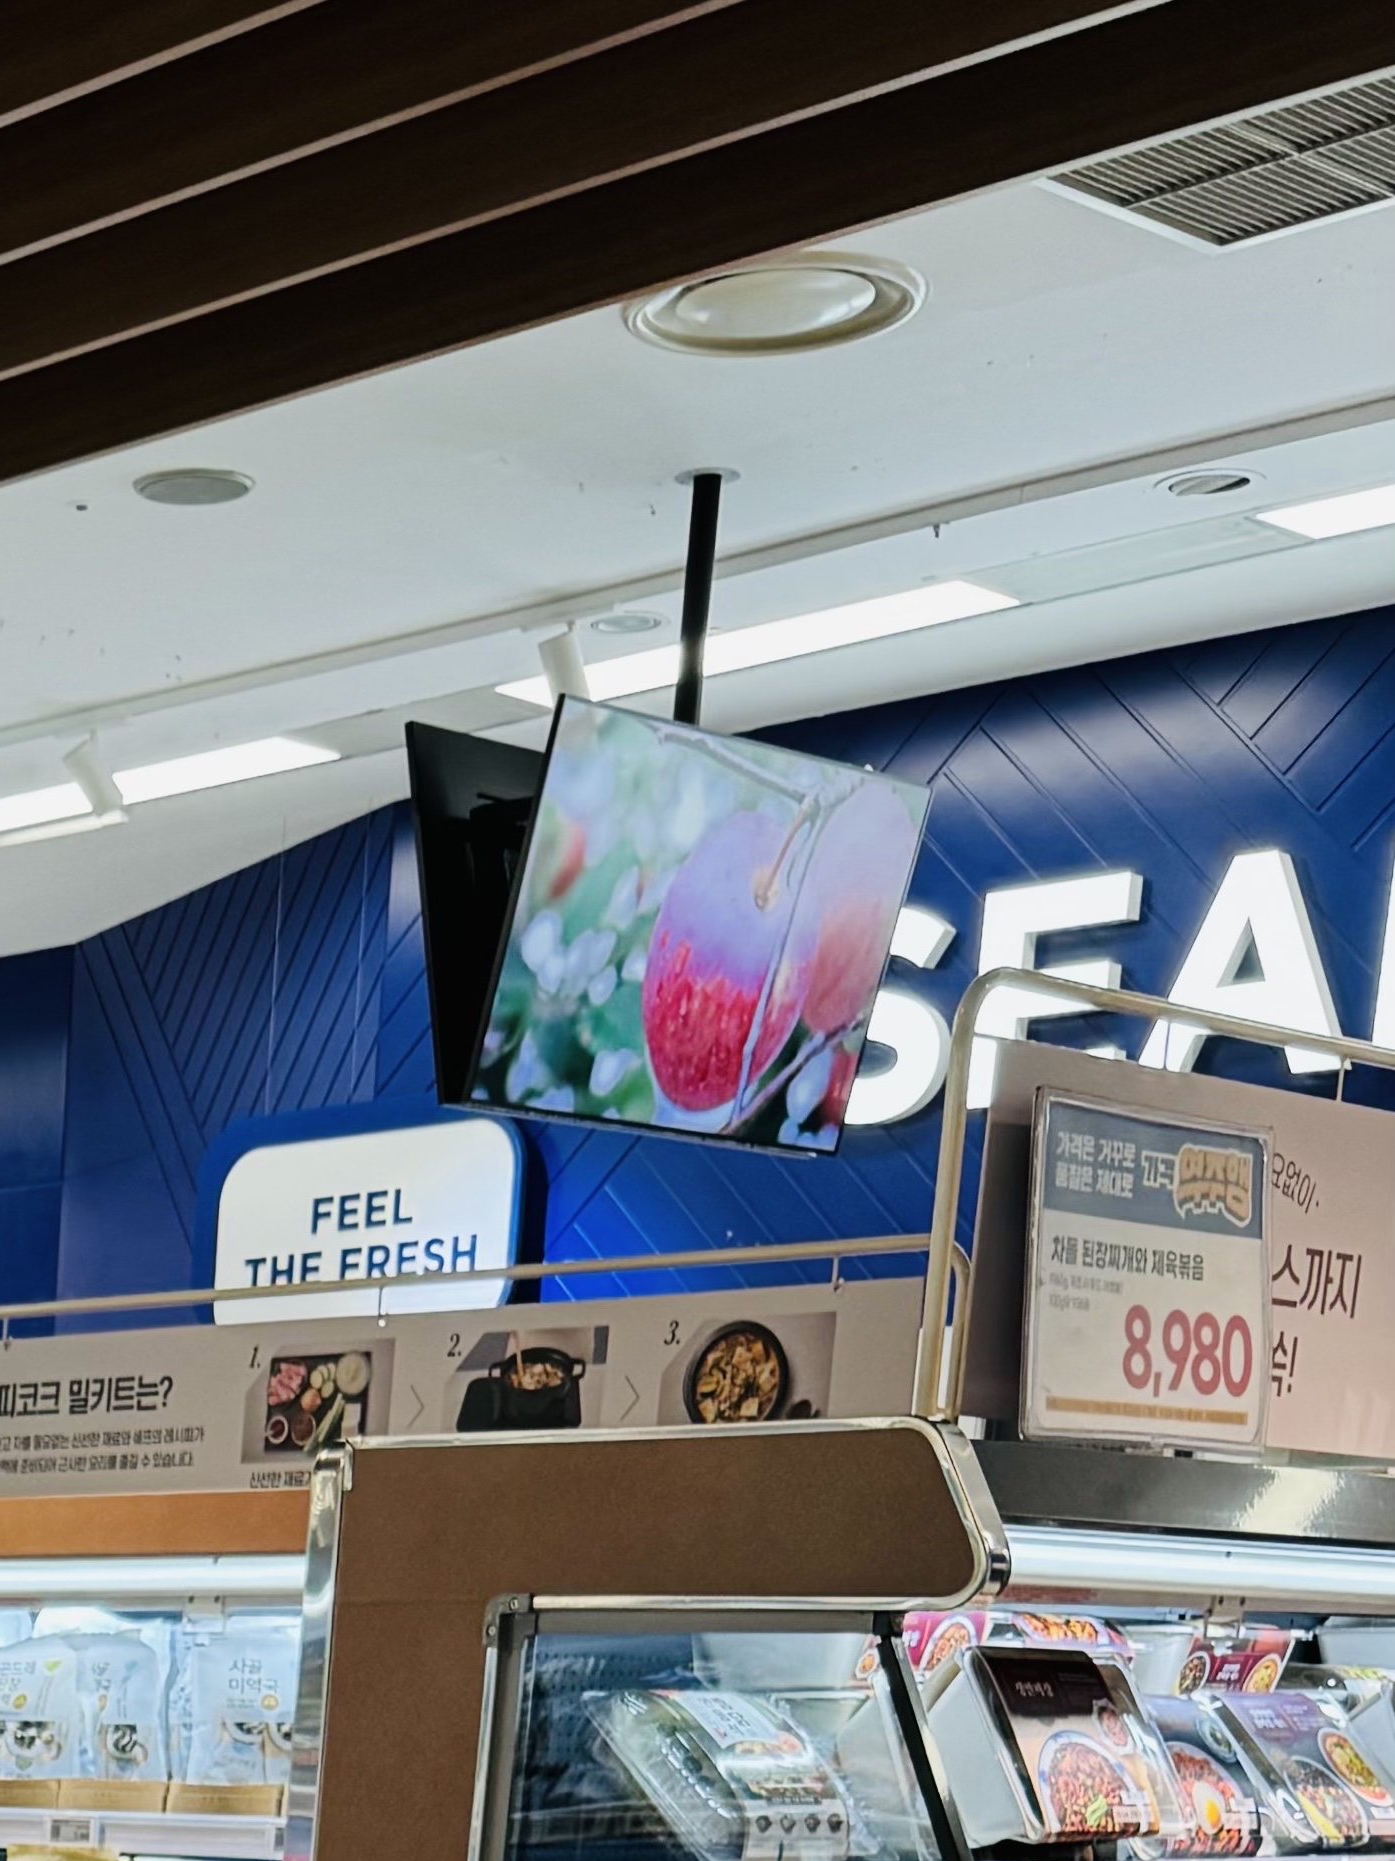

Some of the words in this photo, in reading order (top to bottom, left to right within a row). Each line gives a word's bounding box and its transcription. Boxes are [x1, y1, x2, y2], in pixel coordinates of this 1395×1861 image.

[311, 1189, 414, 1236] FEEL
[339, 1234, 480, 1281] FRESH
[1151, 1249, 1204, 1281] 제육볶음
[1271, 1244, 1362, 1320] 스까지
[1121, 1303, 1253, 1398] 8,980
[69, 1375, 173, 1415] 밀키트는?
[229, 1677, 289, 1694] 미역국
[230, 1658, 273, 1675] 사골
